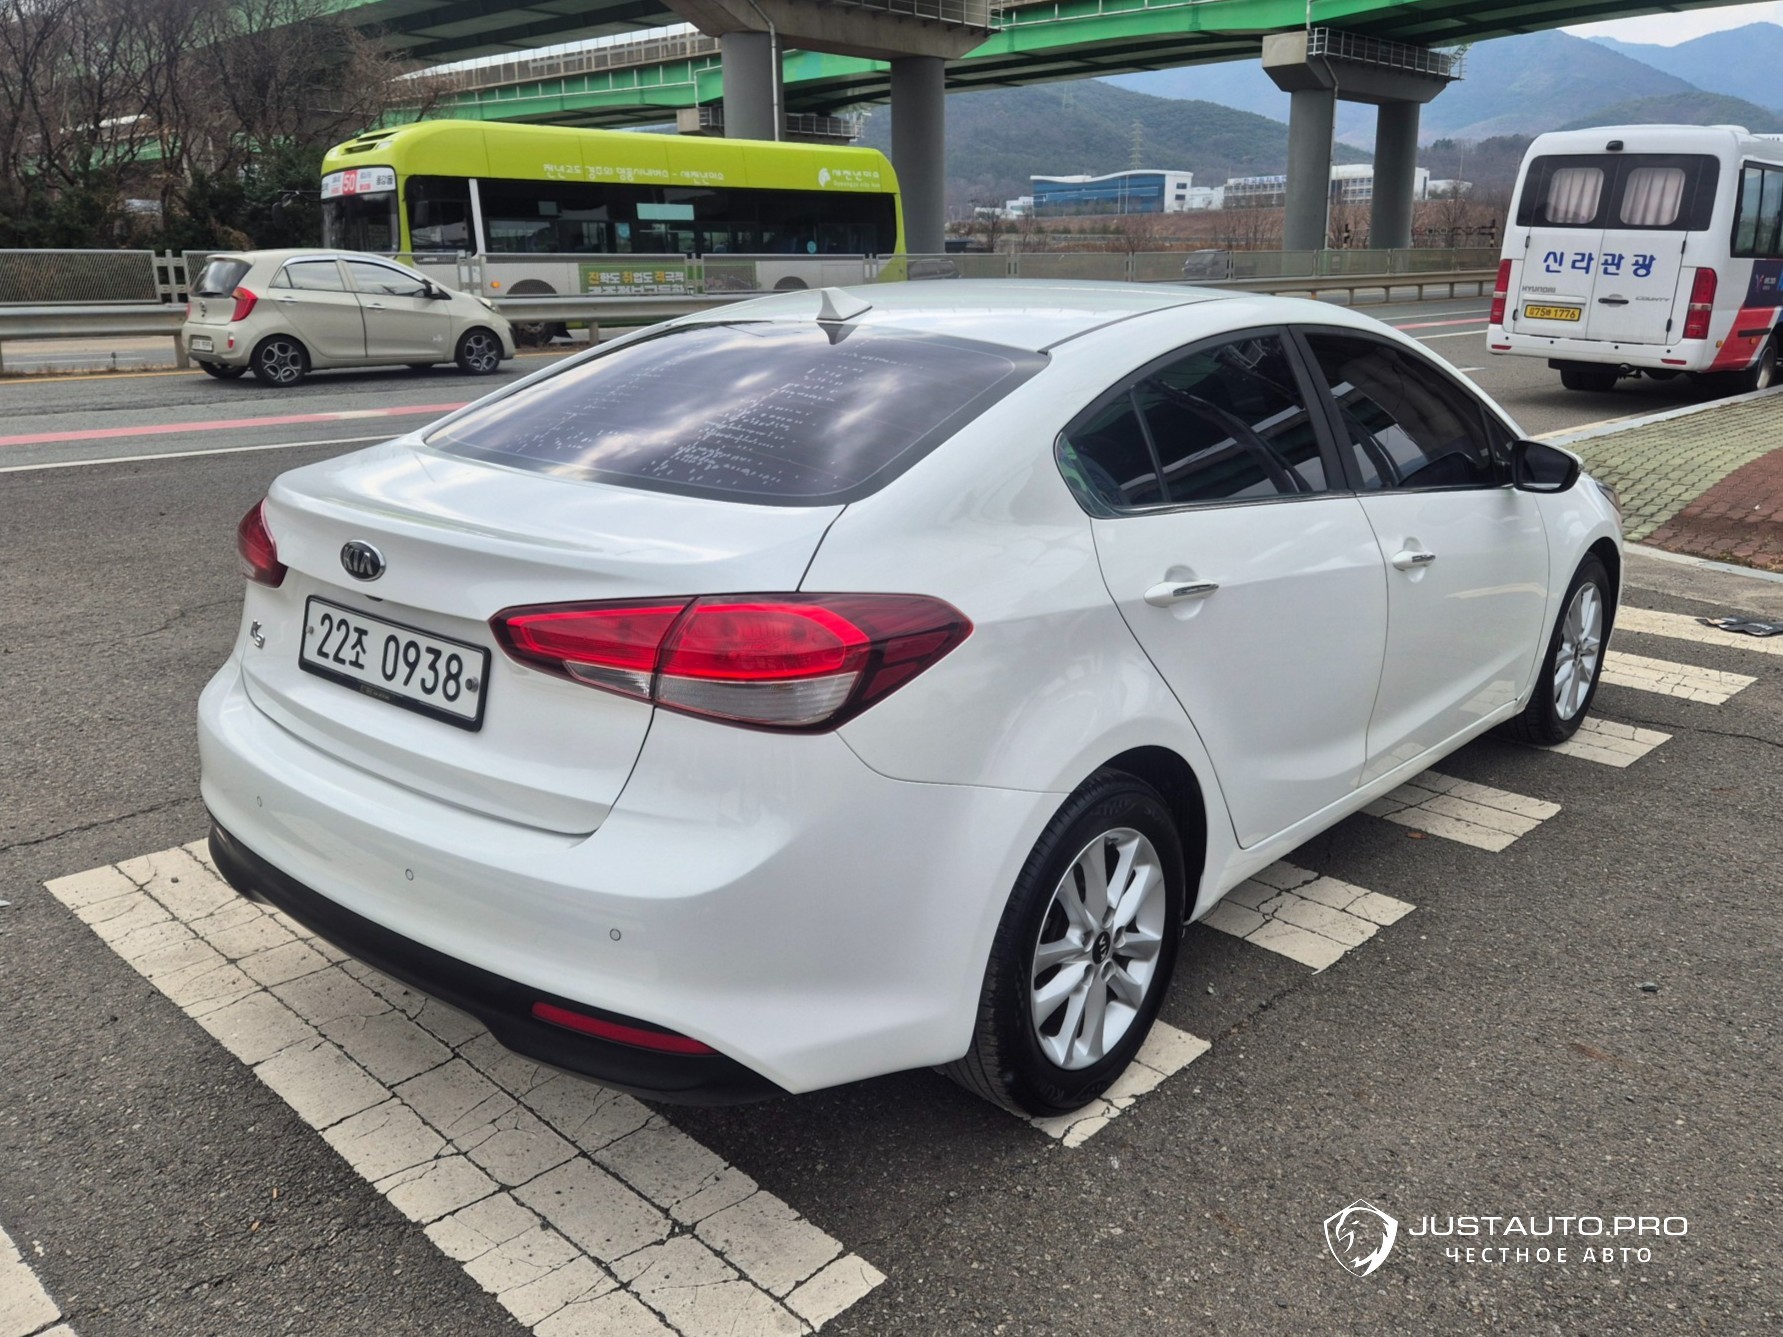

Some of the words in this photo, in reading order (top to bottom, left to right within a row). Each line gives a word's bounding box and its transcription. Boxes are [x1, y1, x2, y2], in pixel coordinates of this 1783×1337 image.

[343, 173, 356, 192] 50
[1543, 251, 1656, 278] 신라관광
[1522, 285, 1556, 294] HYUNDAI
[1553, 307, 1577, 319] 1776
[316, 613, 369, 671] 22조
[381, 634, 464, 703] 0938
